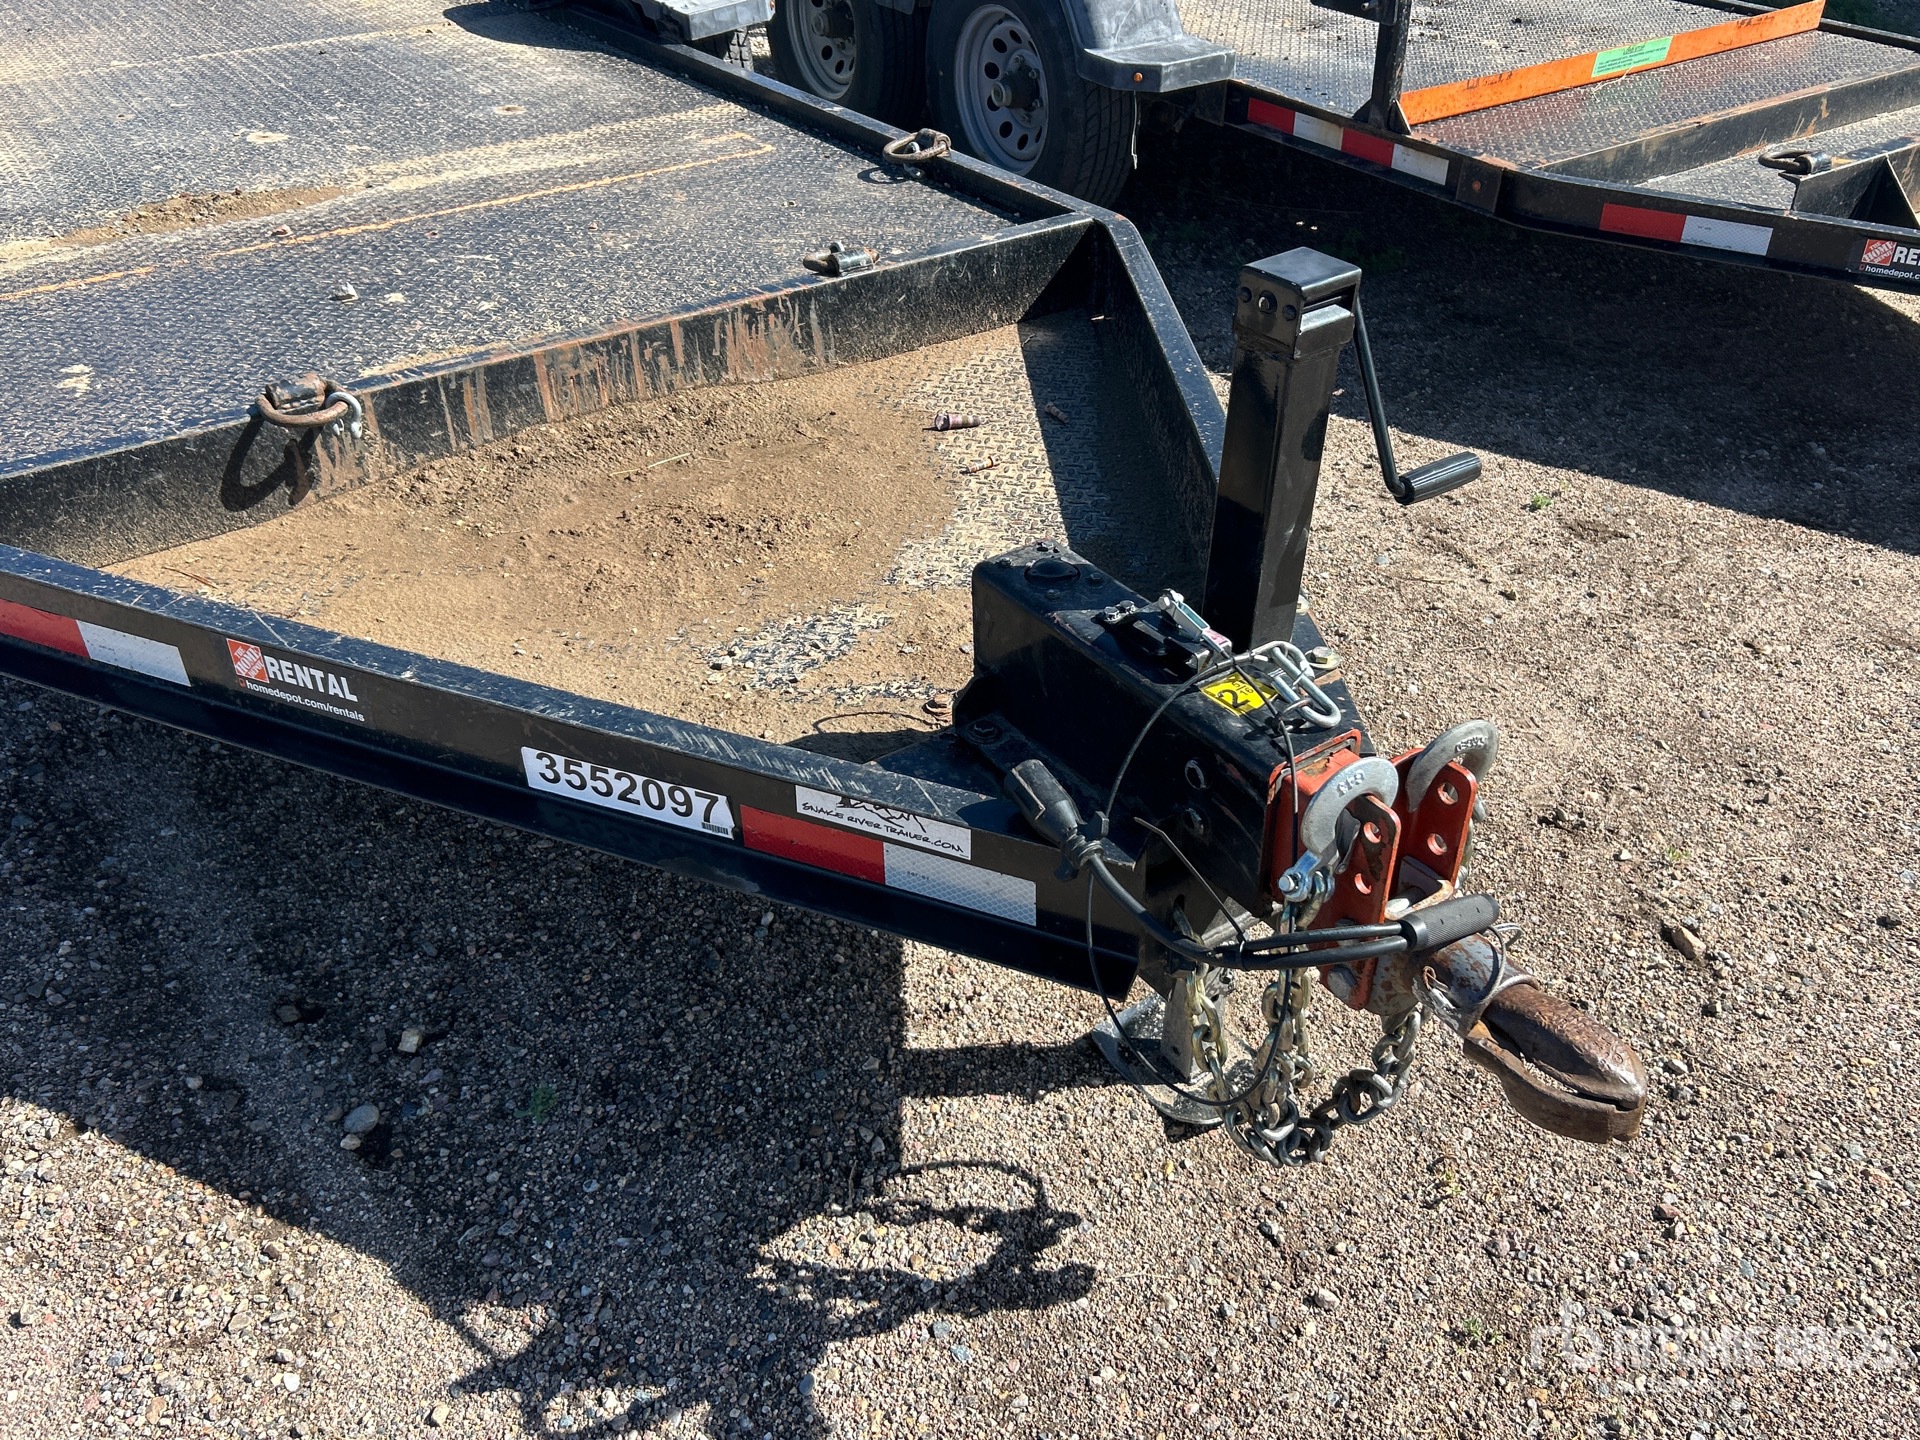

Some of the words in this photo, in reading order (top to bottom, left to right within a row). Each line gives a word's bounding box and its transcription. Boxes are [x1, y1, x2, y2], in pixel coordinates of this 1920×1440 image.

[1893, 246, 1920, 266] RE
[235, 647, 261, 676] HOME
[263, 655, 359, 702] RENTAL
[246, 680, 365, 721] homedepot.com/rentals
[1217, 689, 1250, 708] 2
[536, 752, 719, 823] 3552097
[802, 802, 845, 819] SNAKE
[847, 815, 883, 829] RIVER
[884, 824, 964, 853] TRAILER.COM
